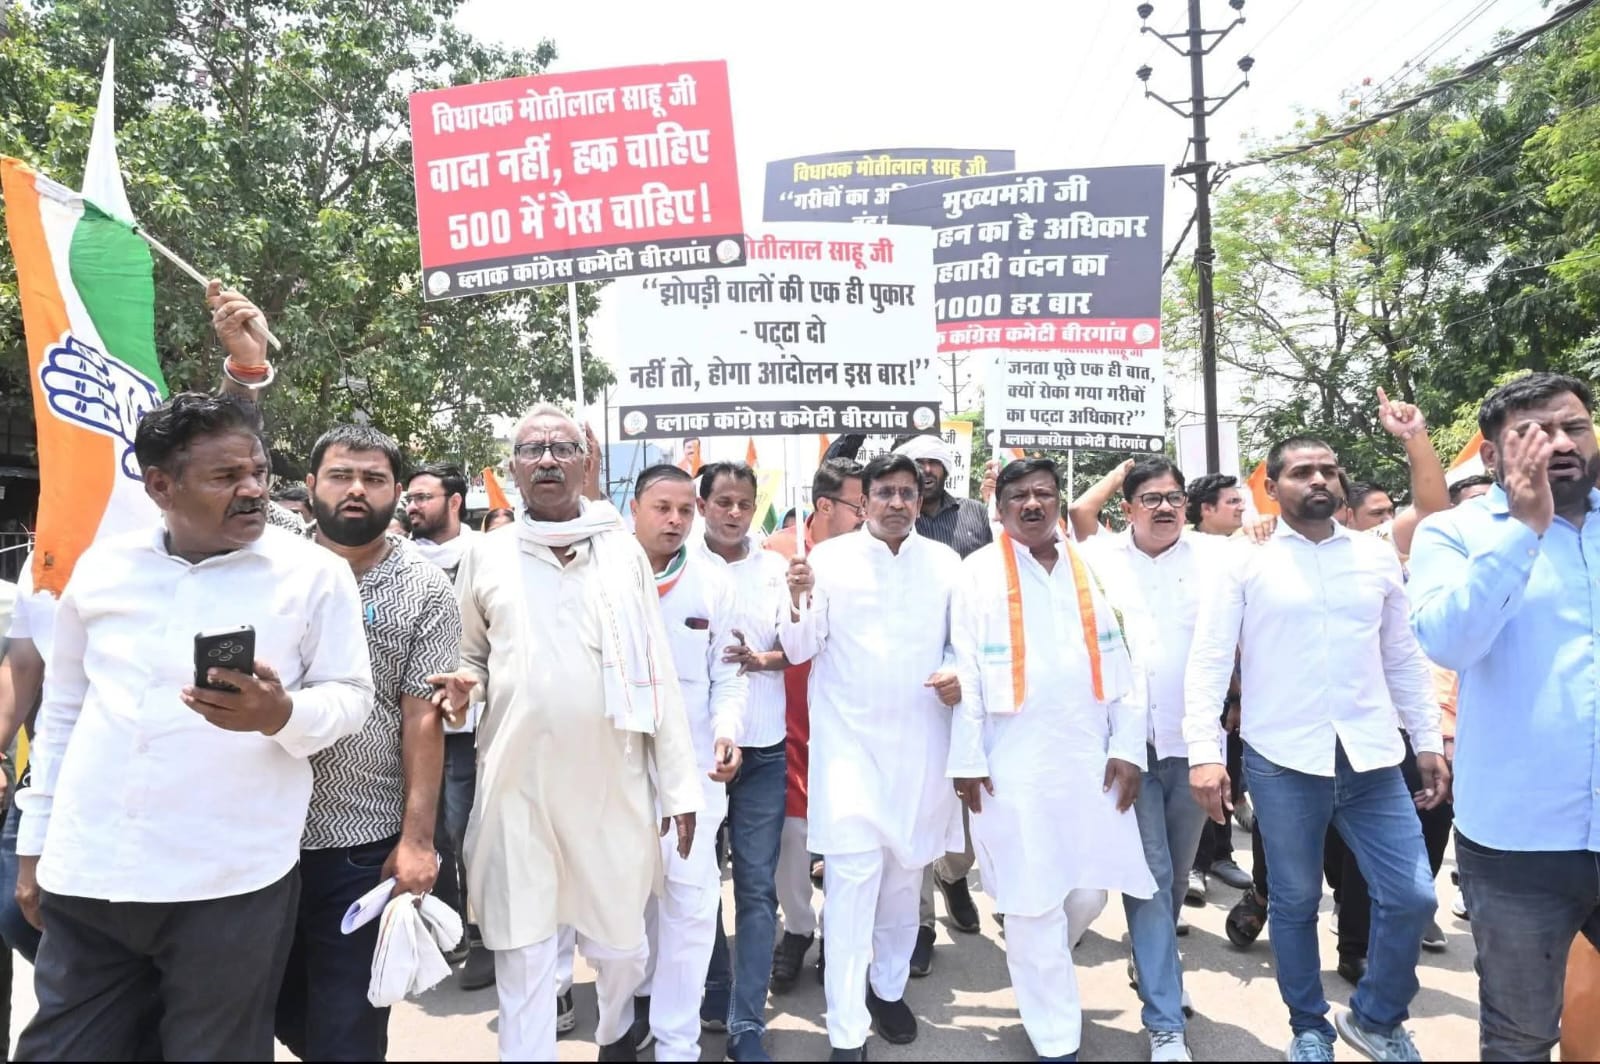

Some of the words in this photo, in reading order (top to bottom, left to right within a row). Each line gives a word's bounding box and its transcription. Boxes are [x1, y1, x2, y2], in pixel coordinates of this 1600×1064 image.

[431, 101, 514, 135] विधायक
[518, 86, 615, 123] मोतीलाल
[621, 82, 667, 118] साहू
[666, 73, 697, 107] जी
[427, 151, 490, 193] वादा
[496, 133, 562, 186] नहीं,
[570, 137, 618, 175] हक
[624, 121, 711, 168] चाहिए
[793, 161, 853, 183] विधायक
[856, 154, 929, 176] मोतीलाल
[966, 155, 988, 176] जी
[779, 184, 844, 210] “गरीबों
[845, 188, 870, 206] का
[942, 176, 1048, 219] मुख्यमंत्री
[1054, 174, 1091, 202] जी
[448, 208, 511, 250] 500
[519, 192, 546, 239] में
[551, 190, 603, 236] गैस
[934, 224, 974, 248] हन
[978, 220, 1012, 243] का
[1013, 212, 1038, 241] है
[1043, 211, 1149, 240] अधिकार
[457, 266, 509, 289] ब्लाक
[512, 255, 573, 280] कांग्रेस
[577, 247, 634, 274] कमेटी
[639, 240, 711, 267] बीरगांव
[744, 233, 823, 260] ोतीलाल
[828, 241, 867, 270] साहू
[868, 237, 894, 264] जी
[934, 252, 1003, 284] हतारी
[1008, 249, 1067, 277] वंदन
[1071, 254, 1109, 277] का
[642, 275, 721, 309] “झोपड़ी
[727, 273, 775, 305] वालों
[778, 274, 804, 303] की
[809, 281, 841, 304] एक
[845, 276, 864, 305] ही
[869, 282, 915, 313] पुकार
[935, 294, 1002, 320] 1000
[1010, 293, 1043, 315] हर
[1047, 292, 1093, 315] बार
[806, 314, 826, 344] दो
[949, 324, 1001, 345] कांग्रेस
[1005, 322, 1056, 343] कमेटी
[1061, 321, 1127, 343] बीरगांव
[630, 357, 666, 389] नहीं
[670, 356, 700, 391] तो,
[708, 356, 752, 386] होगा
[758, 354, 838, 386] आंदोलन
[843, 361, 872, 388] इस
[1053, 358, 1076, 380] पूछे
[1080, 363, 1104, 377] एक
[1107, 360, 1122, 378] ही
[1126, 365, 1155, 383] बात,
[1007, 381, 1037, 399] क्यों
[1039, 381, 1071, 400] रोका
[1074, 386, 1103, 401] गया
[1106, 384, 1146, 403] गरीबों
[655, 413, 709, 433] ब्लाक
[713, 406, 777, 430] कांग्रेस
[779, 406, 836, 428] कमेटी
[841, 406, 909, 429] बीरगांव
[1006, 408, 1026, 423] का
[1005, 433, 1036, 447] ब्लाक
[1037, 431, 1072, 448] कांग्रेस
[1074, 432, 1106, 449] कमेटी
[1108, 435, 1147, 451] बीरगांव
